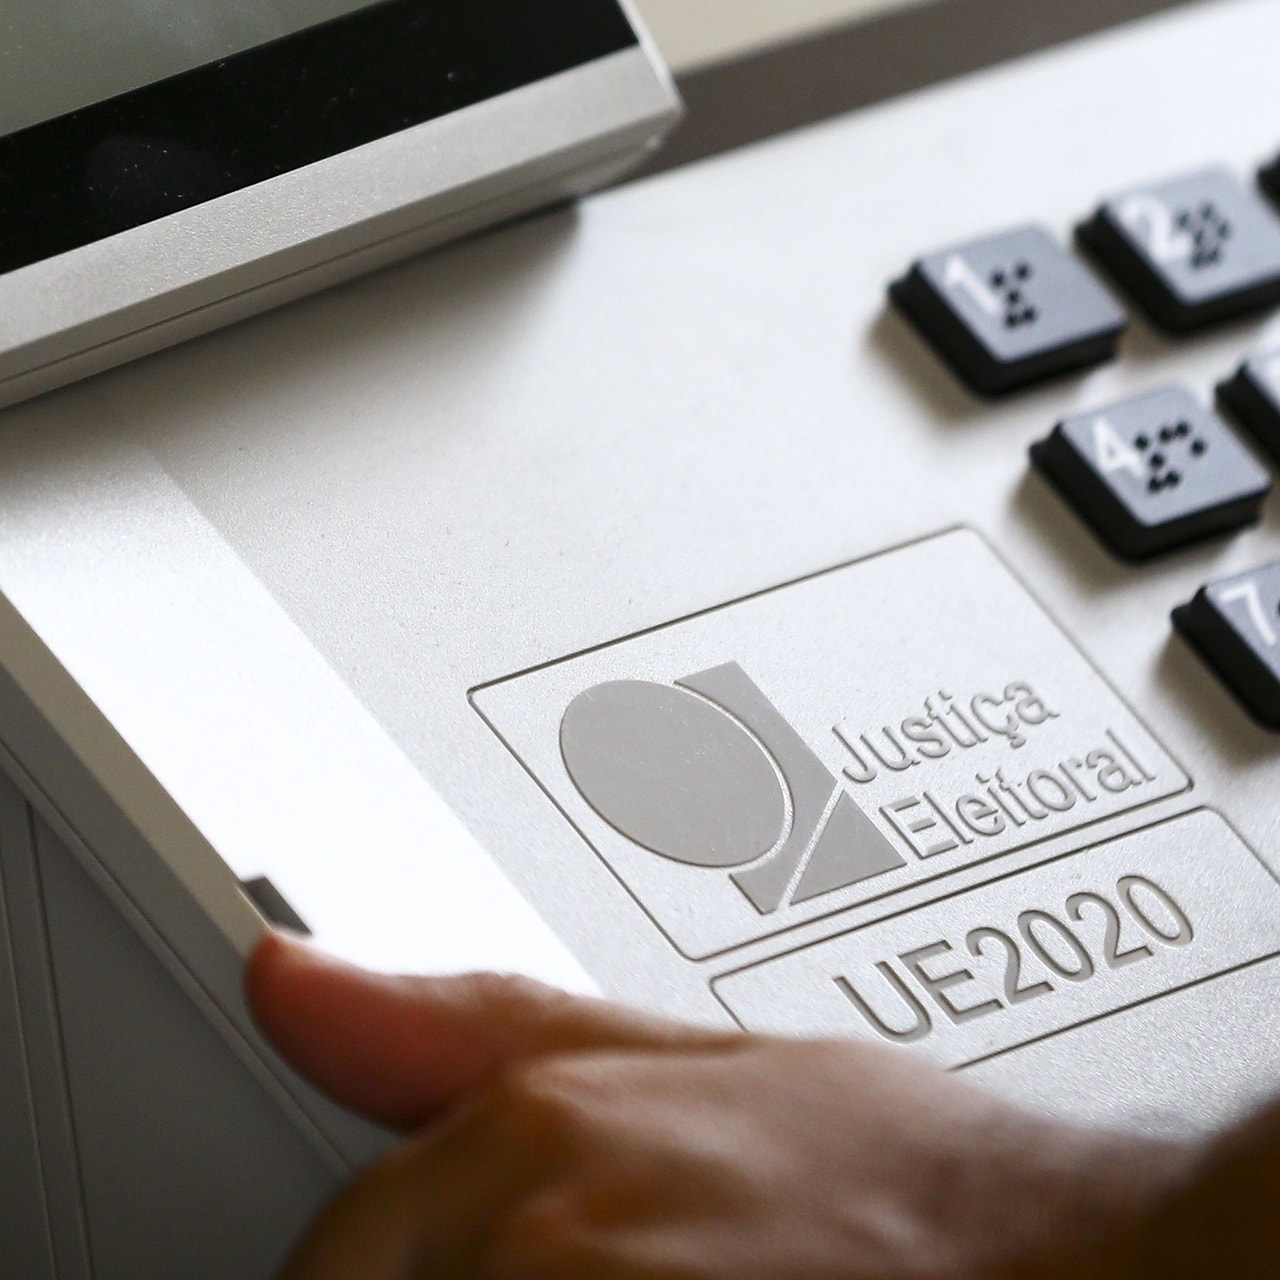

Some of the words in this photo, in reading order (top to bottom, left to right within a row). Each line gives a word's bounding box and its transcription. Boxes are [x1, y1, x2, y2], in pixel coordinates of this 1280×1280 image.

[1122, 194, 1197, 262] 2
[940, 253, 1004, 316] 1
[1091, 417, 1146, 480] 4
[1220, 581, 1278, 647] 7
[830, 680, 1061, 786] Justiça
[877, 727, 1157, 861] Eleitoral
[832, 874, 1195, 1045] UE2020
